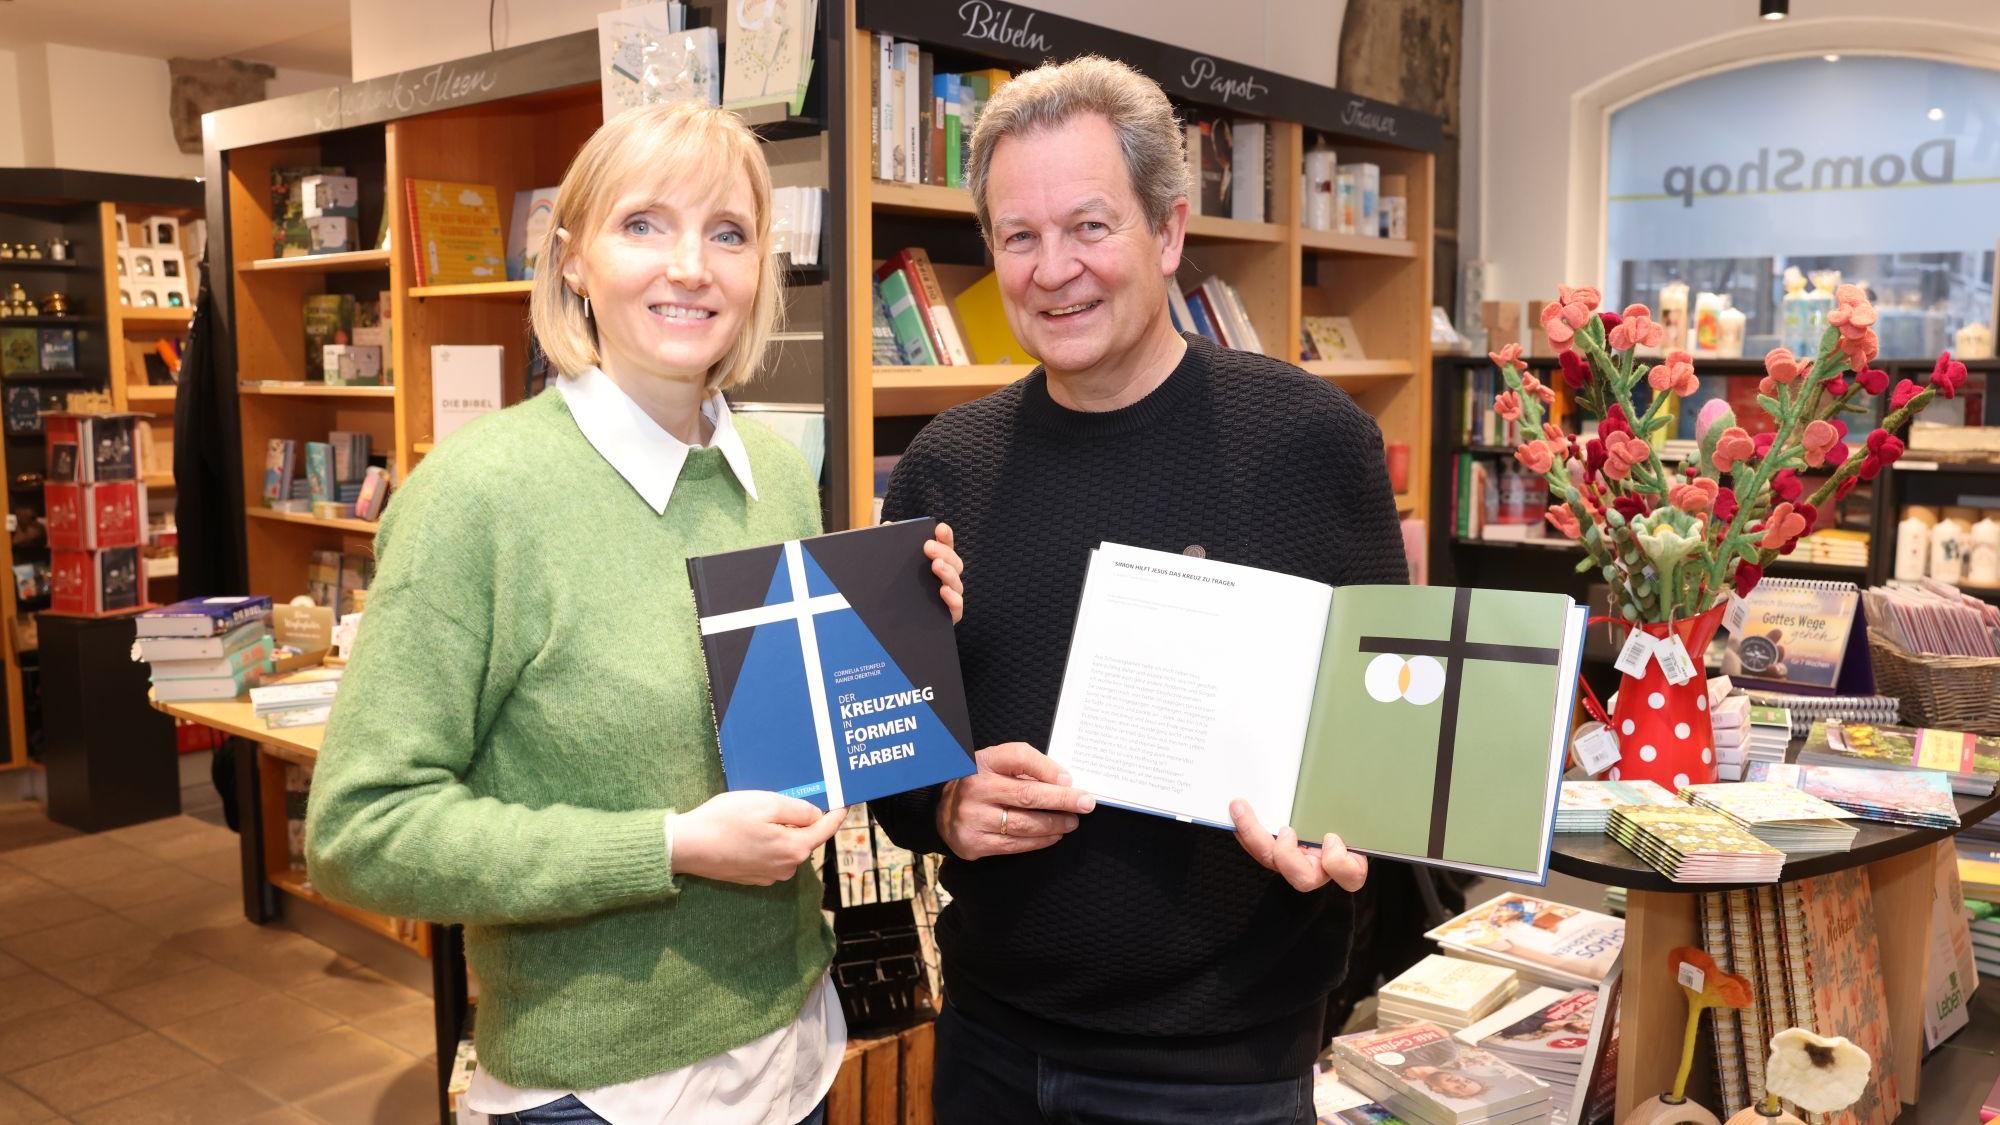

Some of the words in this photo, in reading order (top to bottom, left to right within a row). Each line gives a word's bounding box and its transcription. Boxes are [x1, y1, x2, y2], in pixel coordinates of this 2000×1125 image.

[957, 0, 1053, 53] Bibeln
[1340, 99, 1397, 138] Trauer
[442, 400, 460, 408] DIE
[463, 399, 493, 408] BIBEL
[1115, 561, 1134, 569] SIMON
[1135, 564, 1150, 572] HILFT
[1151, 567, 1168, 576] JESUS
[1169, 570, 1181, 578] DAS
[1182, 572, 1201, 581] KREUZ
[1202, 575, 1211, 583] ZU
[1211, 577, 1235, 587] TRAGEN
[1762, 612, 1795, 627] Gottes
[1798, 615, 1826, 630] Wege
[834, 667, 859, 678] CORNELIA
[859, 661, 886, 672] STEINFELD
[835, 675, 854, 684] RAINER
[838, 693, 856, 704] DER
[840, 686, 935, 719] KREUZWEG
[843, 720, 853, 729] IN
[844, 715, 918, 745] FORMEN
[847, 743, 867, 754] UND
[849, 742, 915, 771] FARBEN
[1935, 990, 1963, 1020] Leben
